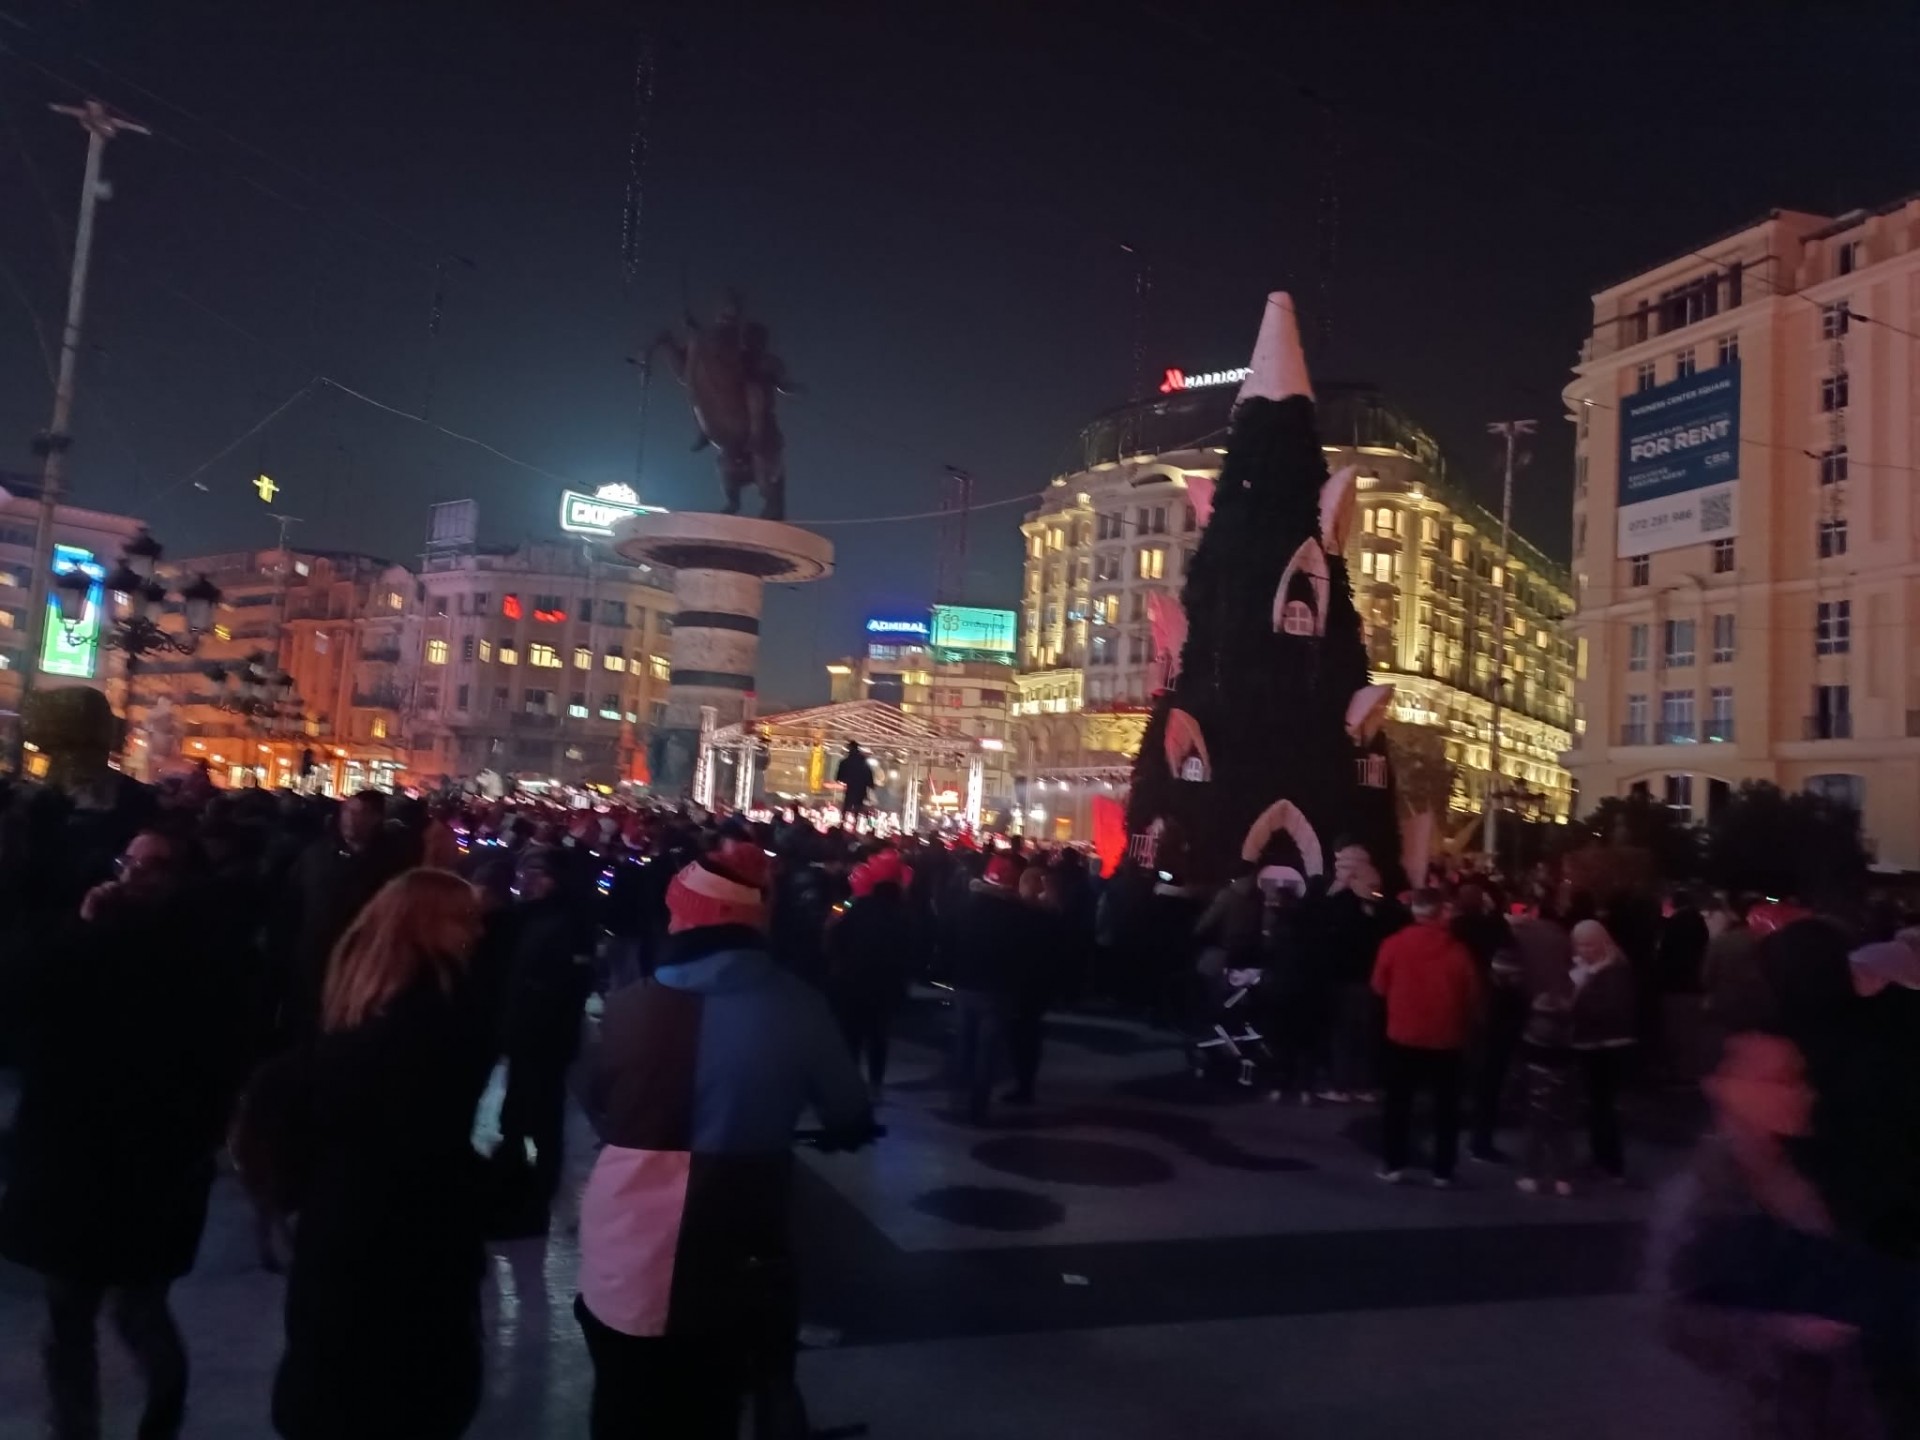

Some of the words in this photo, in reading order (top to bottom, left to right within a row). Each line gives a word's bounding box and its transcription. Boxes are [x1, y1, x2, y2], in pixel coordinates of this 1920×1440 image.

[1630, 437, 1671, 463] FOR
[1674, 420, 1731, 450] RENT
[866, 619, 930, 634] ADMIRAL
